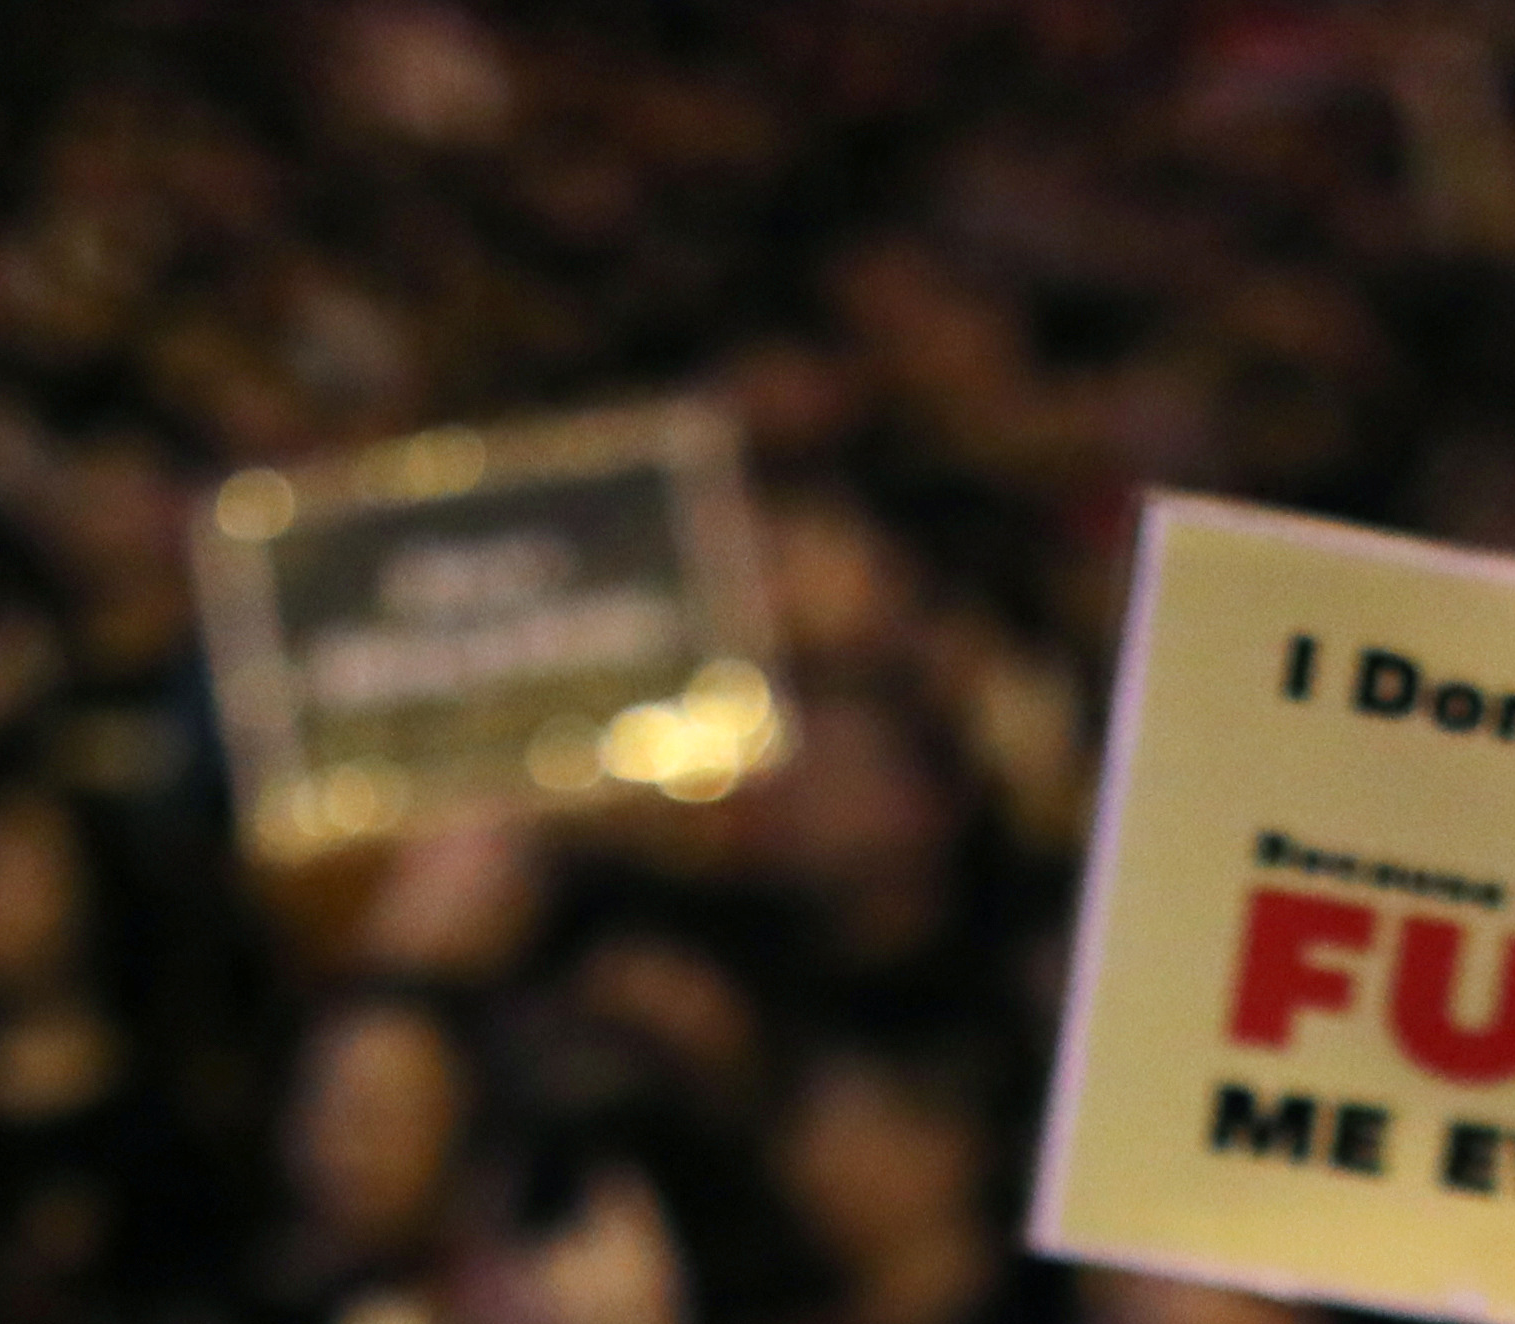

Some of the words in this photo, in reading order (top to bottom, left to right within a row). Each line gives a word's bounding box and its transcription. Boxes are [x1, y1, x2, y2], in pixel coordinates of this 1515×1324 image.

[1285, 636, 1316, 700] I
[1259, 834, 1502, 906] Because
[1212, 1085, 1387, 1172] ME
